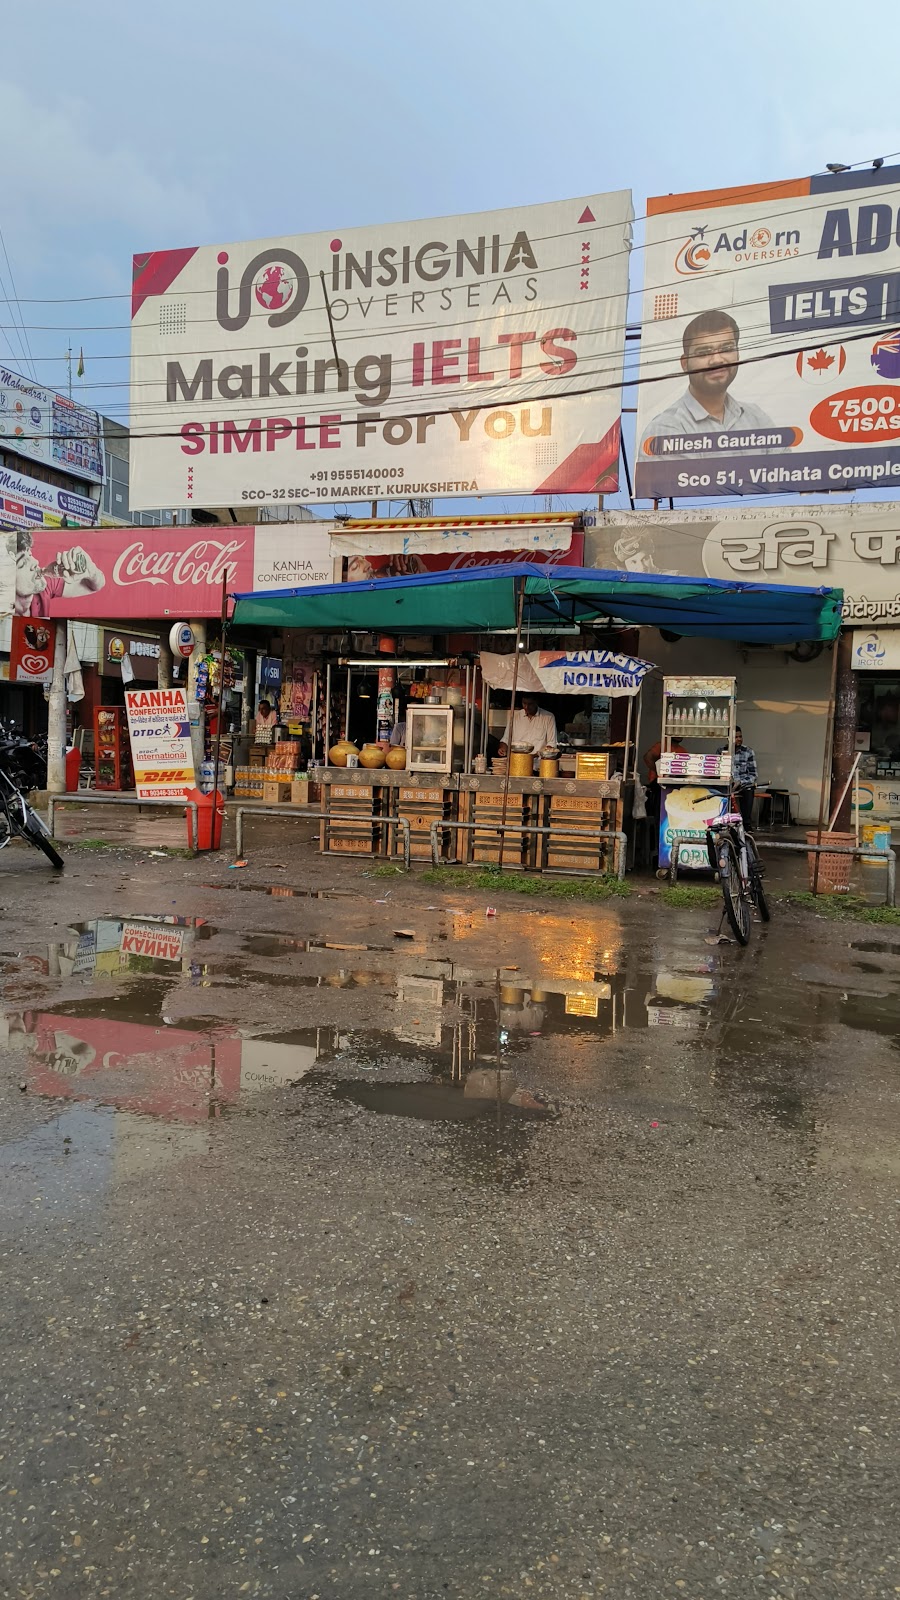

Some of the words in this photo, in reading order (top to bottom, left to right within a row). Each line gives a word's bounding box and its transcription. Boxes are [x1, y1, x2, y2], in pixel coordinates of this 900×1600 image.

[817, 203, 900, 259] AD
[735, 247, 800, 263] OVERSEAS
[330, 277, 538, 322] OVERSEAS
[784, 286, 868, 322] IELTS
[166, 346, 392, 407] Making
[412, 327, 578, 387] IELTS
[828, 396, 900, 418] 7500
[181, 414, 341, 456] SIMPLE
[356, 413, 436, 447] For
[448, 405, 552, 442] You
[663, 433, 713, 452] Nilesh
[720, 432, 782, 450] Gautam
[309, 469, 330, 482] +91
[332, 467, 405, 481] 9555140003
[677, 472, 711, 487] Sco
[716, 470, 744, 488] 51,
[749, 466, 822, 485] Vidhata
[241, 487, 286, 501] SCO-32
[288, 485, 328, 499] SEC-10
[386, 479, 479, 495] KURUKSHETRA
[720, 521, 836, 571] रवि
[113, 539, 248, 587] Coca-Cola
[273, 560, 313, 572] KANHA
[257, 571, 329, 583] CONFECTIONERY
[269, 667, 280, 679] SBI
[127, 690, 186, 709] KANHA
[129, 706, 186, 717] CONFECTIONERY
[132, 728, 163, 737] DTDC
[136, 751, 187, 760] International
[143, 770, 188, 783] DHL
